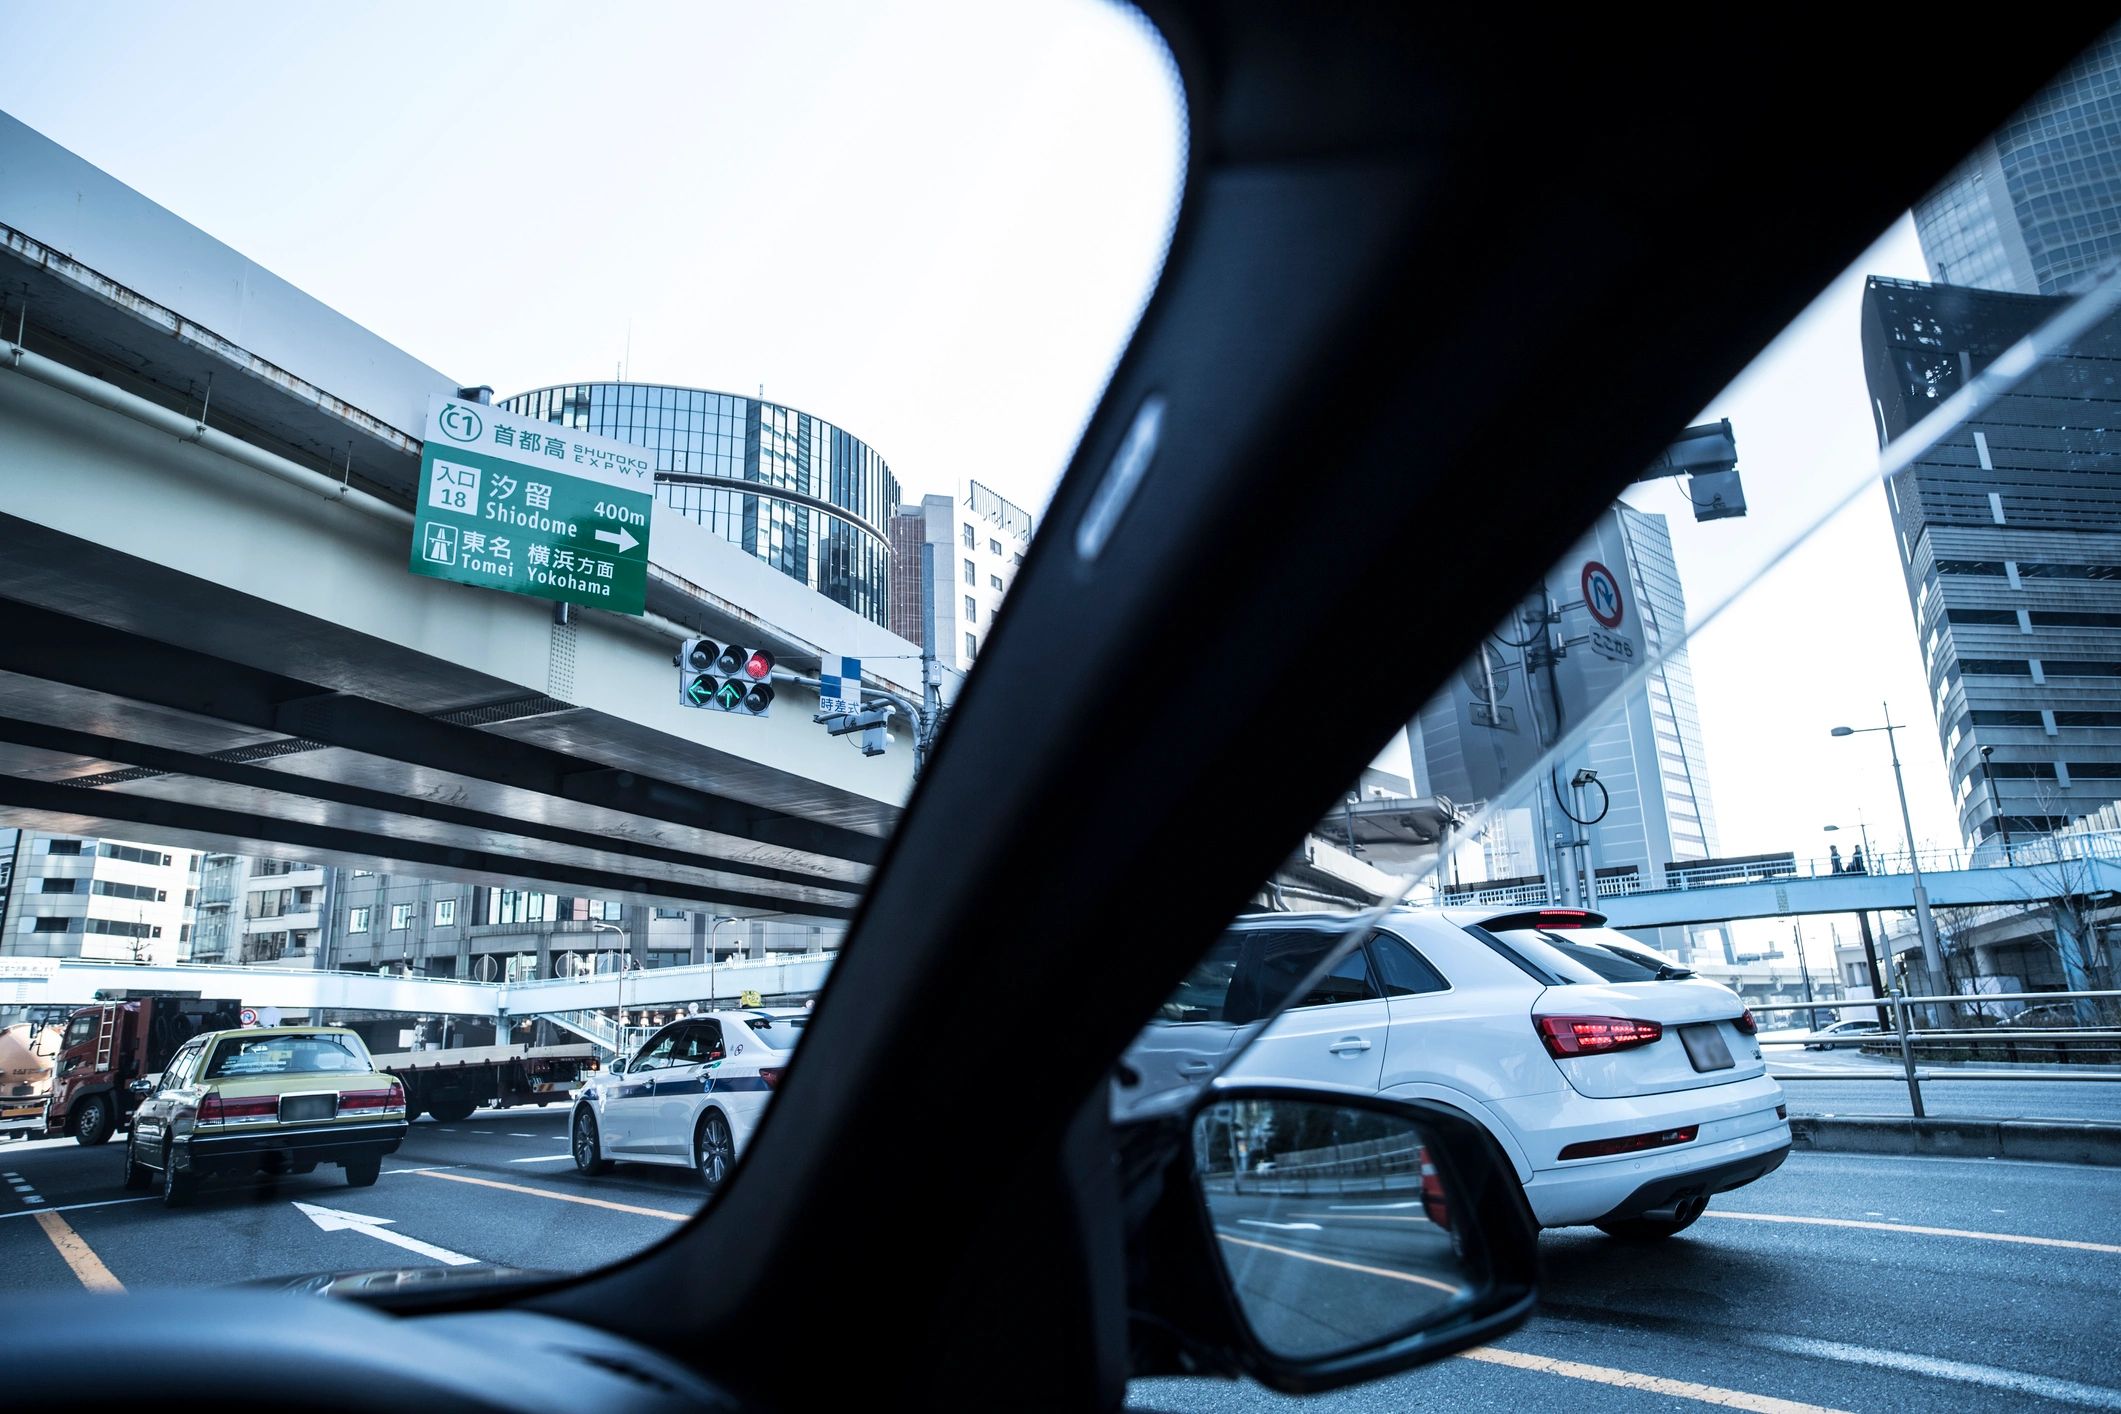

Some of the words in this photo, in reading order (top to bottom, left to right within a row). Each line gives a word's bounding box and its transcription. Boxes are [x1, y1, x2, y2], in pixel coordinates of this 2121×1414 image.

[446, 412, 473, 436] C1
[494, 424, 567, 460] 首都高
[573, 444, 648, 470] SHUTOKO
[437, 466, 475, 489] 入口
[440, 489, 466, 508] 18
[490, 473, 552, 511] 汐留
[486, 501, 577, 538] Shiodome
[594, 501, 645, 527] 400m
[462, 530, 511, 560] 東名
[528, 543, 615, 580] 横浜方面
[461, 554, 513, 578] Tomei
[527, 566, 611, 597] Yokohama
[1593, 632, 1633, 657] ここから
[821, 698, 859, 715] 時差式
